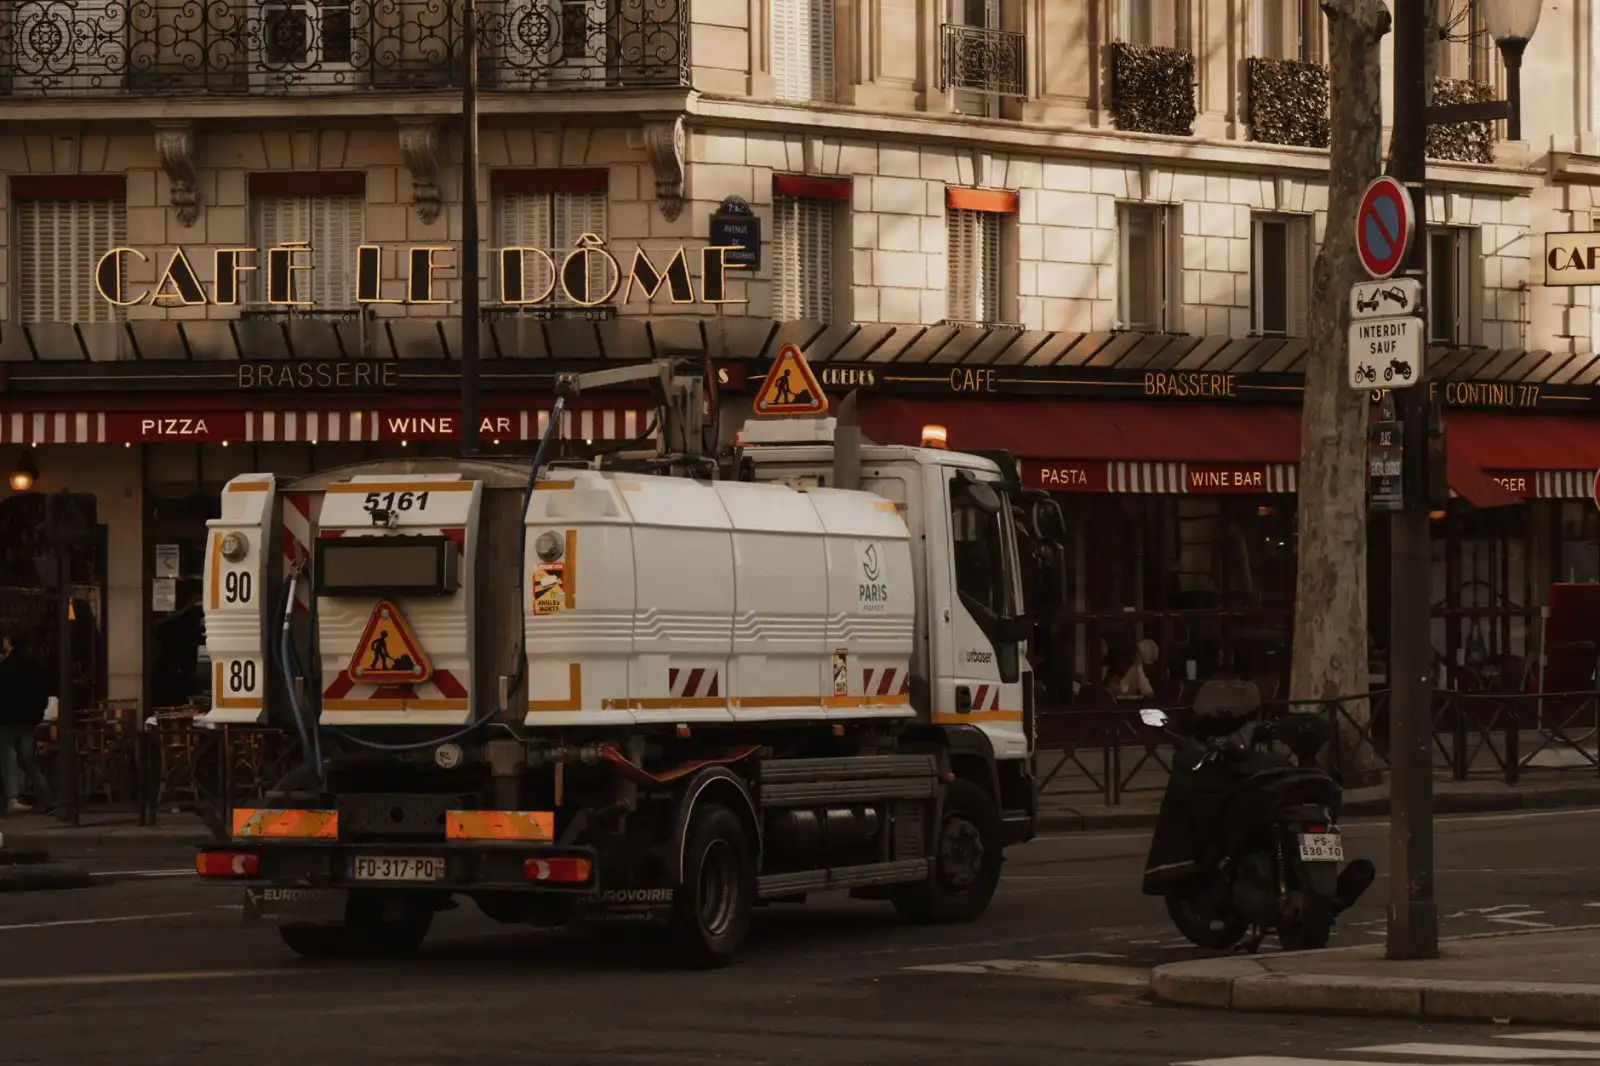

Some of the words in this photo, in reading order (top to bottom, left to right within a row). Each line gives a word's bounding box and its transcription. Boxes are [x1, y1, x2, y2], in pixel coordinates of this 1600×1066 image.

[1548, 246, 1600, 271] CAF
[356, 245, 455, 304] LE
[500, 233, 748, 306] DÔME
[1359, 322, 1406, 339] INTERDIT
[1370, 340, 1397, 354] SAUF
[238, 362, 399, 389] BRASSERIE
[1144, 371, 1237, 397] BRASSERIE
[1446, 382, 1514, 405] CONTINU
[141, 418, 209, 435] PIZZA
[387, 417, 453, 433] WINE
[479, 417, 511, 433] AR
[1040, 468, 1088, 485] PASTA
[1190, 471, 1229, 487] WINE
[1234, 471, 1263, 487] BAR
[363, 491, 429, 511] 5161
[225, 571, 252, 603] 90
[859, 583, 888, 602] PARIS
[229, 660, 256, 692] 80
